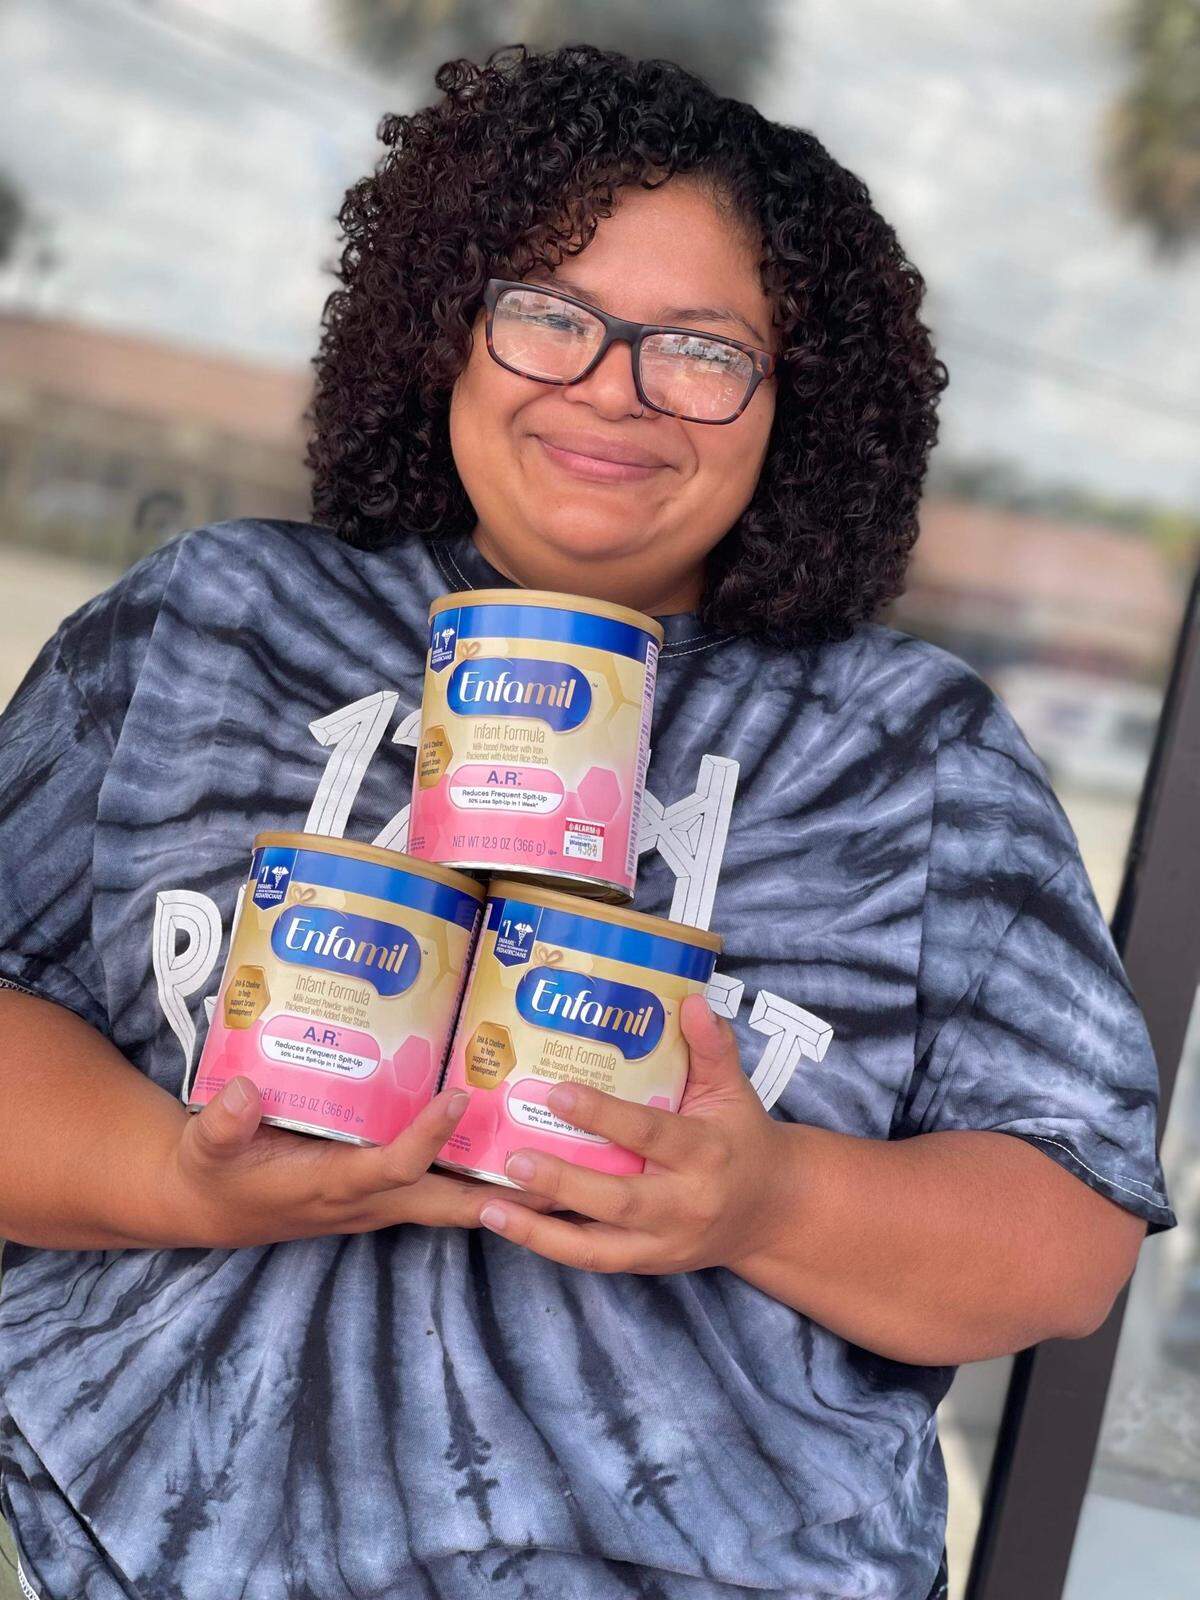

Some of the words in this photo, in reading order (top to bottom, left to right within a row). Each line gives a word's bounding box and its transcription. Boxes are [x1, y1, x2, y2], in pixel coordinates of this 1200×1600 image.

[459, 671, 577, 709] Enfamil
[473, 723, 501, 740] Infant
[504, 725, 545, 743] Formula
[462, 789, 489, 797] Reduces
[490, 790, 521, 800] Frequent
[522, 792, 548, 802] Spit-Up
[453, 836, 465, 848] NET
[468, 836, 480, 848] WT
[481, 837, 498, 849] 12.9
[500, 838, 511, 850] OZ
[514, 837, 534, 852] (366
[536, 840, 547, 857] g)
[285, 917, 409, 974] Enfamil
[295, 974, 326, 996] Infant
[328, 981, 371, 1006] Formula
[531, 978, 654, 1037] Enfamil
[274, 1040, 304, 1053] Reduces
[305, 1047, 337, 1061] Frequent
[338, 1054, 364, 1067] Spit-Up
[543, 1039, 574, 1061] Infant
[576, 1046, 617, 1071] Formula
[273, 1091, 287, 1105] WT
[288, 1094, 307, 1110] 12.9
[308, 1098, 320, 1113] OZ
[321, 1101, 343, 1118] (366
[344, 1105, 355, 1123] g)
[521, 1104, 552, 1118] Reduces
[539, 1118, 553, 1126] Less
